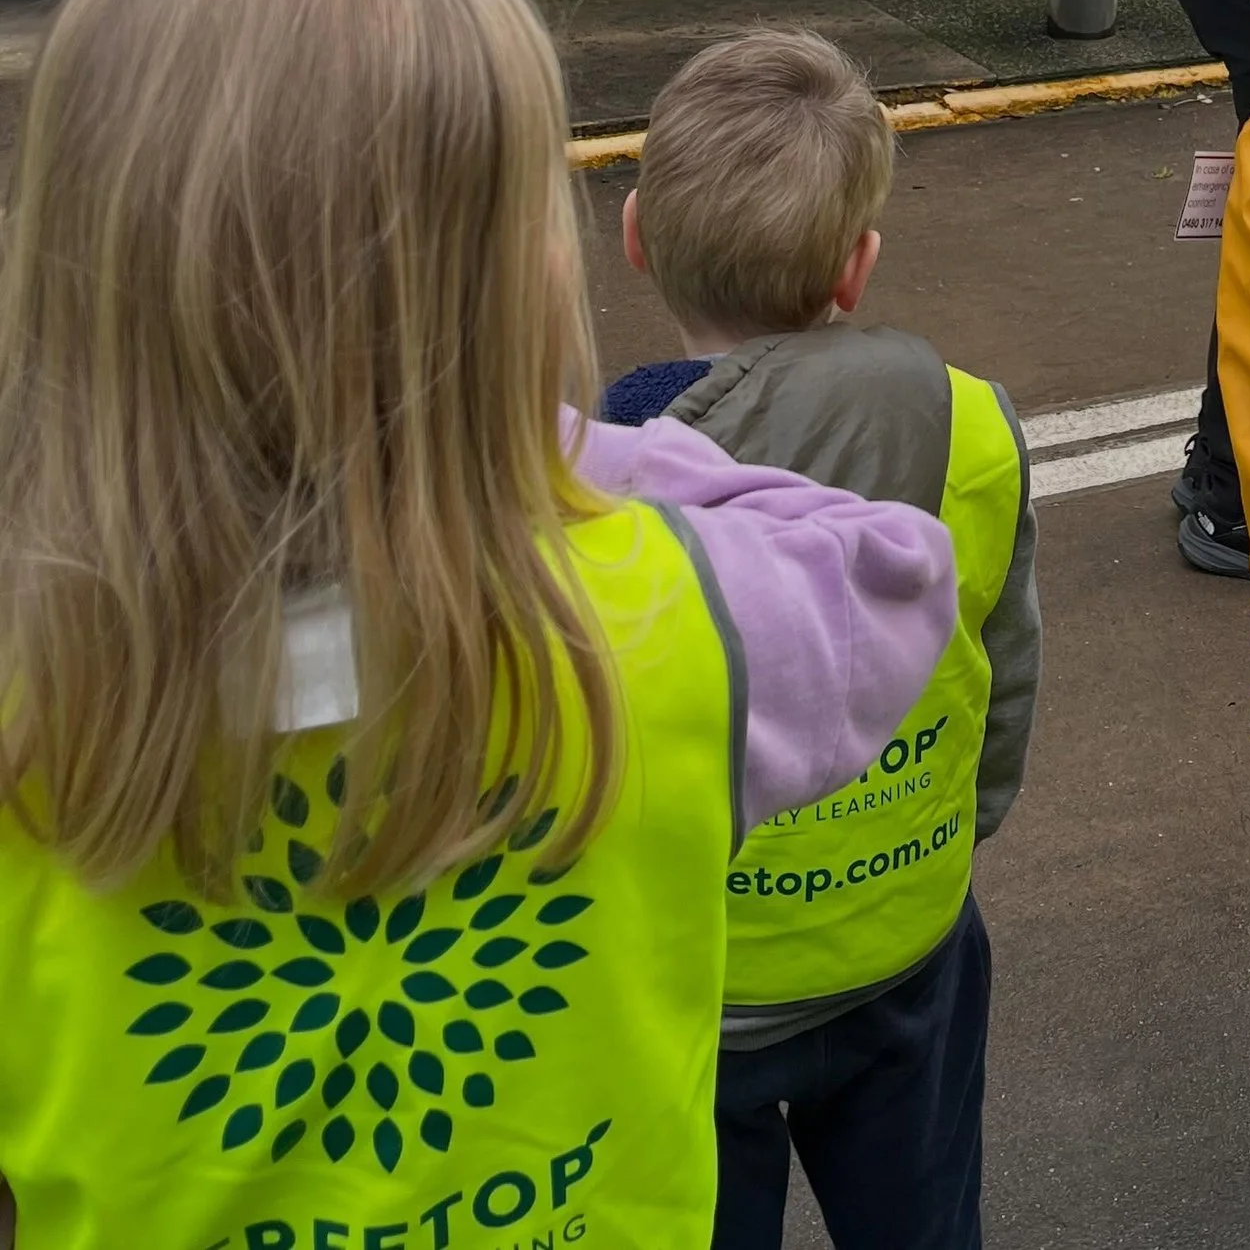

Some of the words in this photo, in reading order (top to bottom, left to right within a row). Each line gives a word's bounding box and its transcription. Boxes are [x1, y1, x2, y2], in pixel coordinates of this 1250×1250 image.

[1204, 166, 1220, 175] case
[1188, 198, 1217, 208] contact
[816, 772, 932, 822] LEARNING
